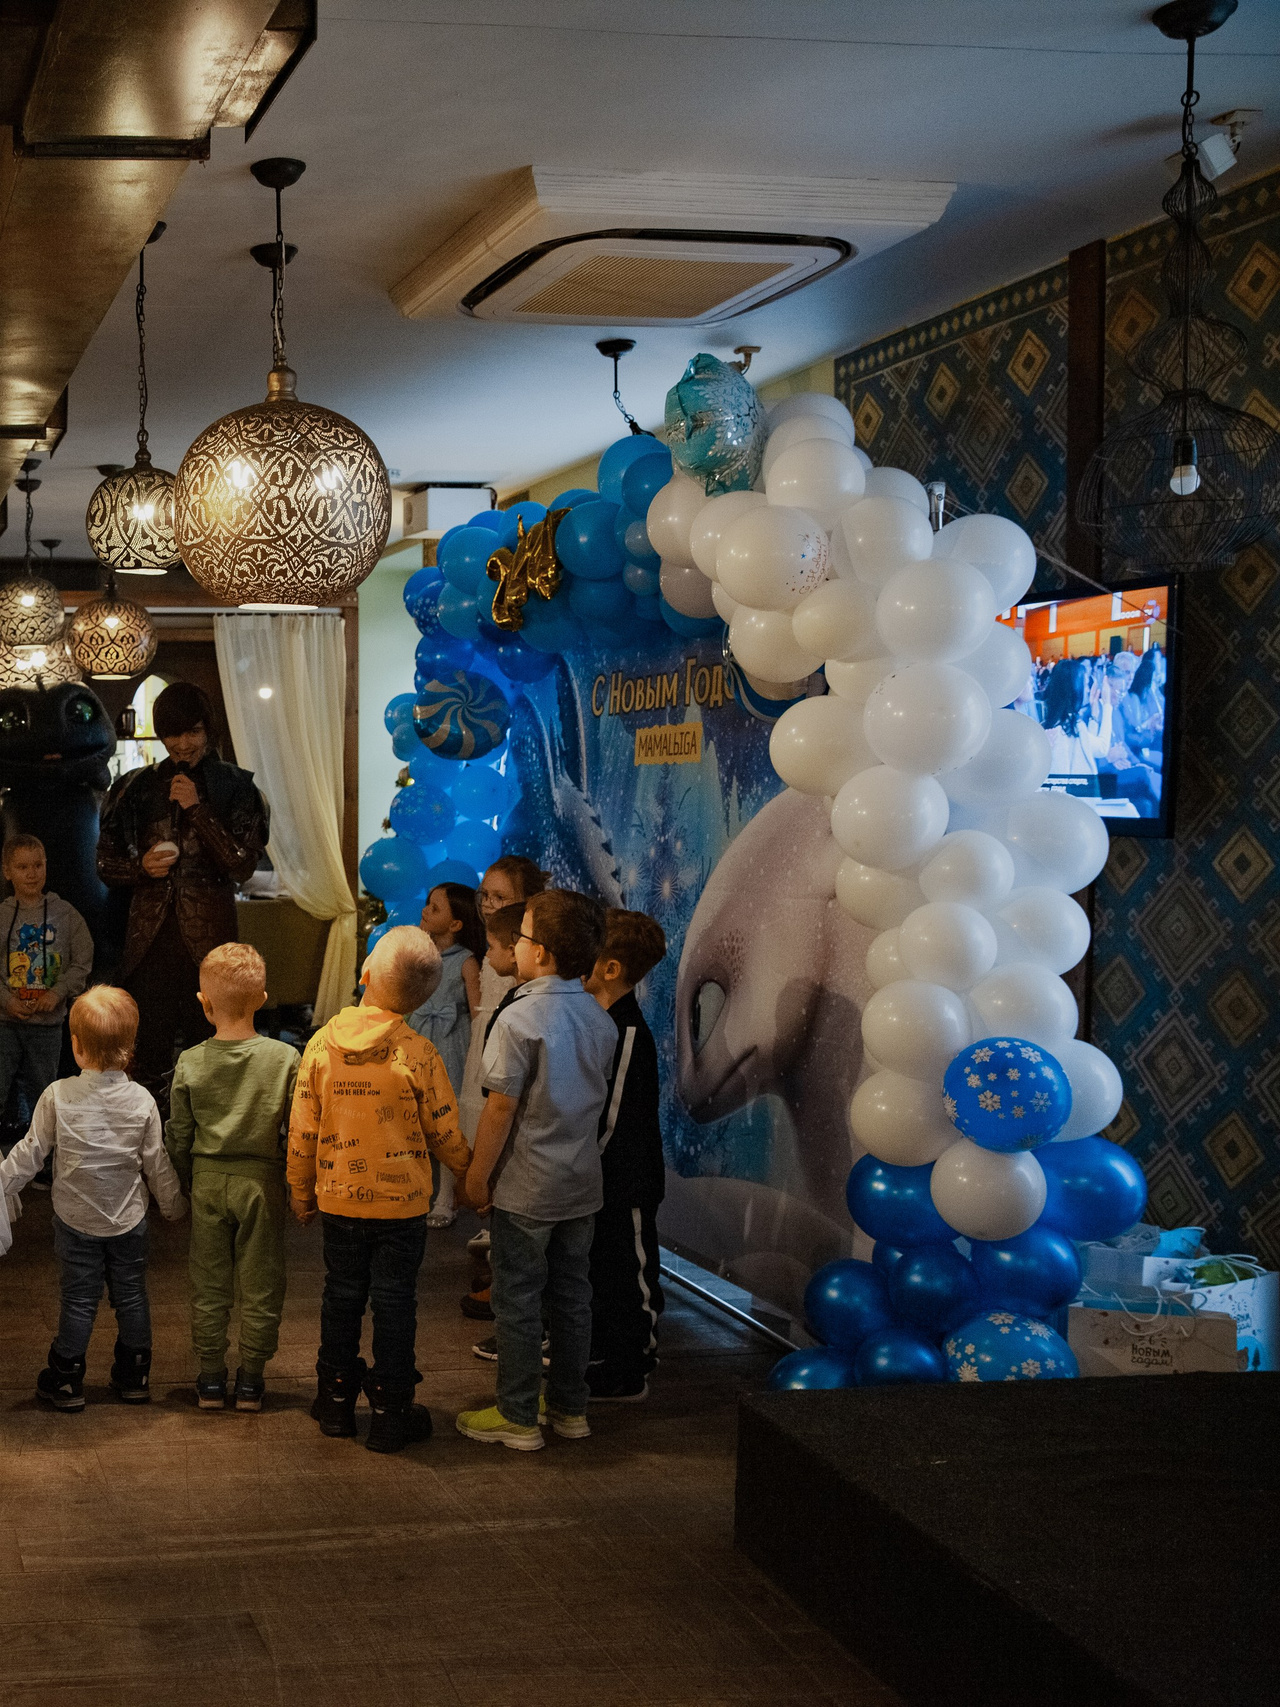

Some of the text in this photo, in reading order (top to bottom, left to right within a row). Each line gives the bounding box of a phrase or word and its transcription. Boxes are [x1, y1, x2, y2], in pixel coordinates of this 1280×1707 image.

[592, 656, 735, 717] С Новым Год
[432, 1104, 452, 1121] NOW
